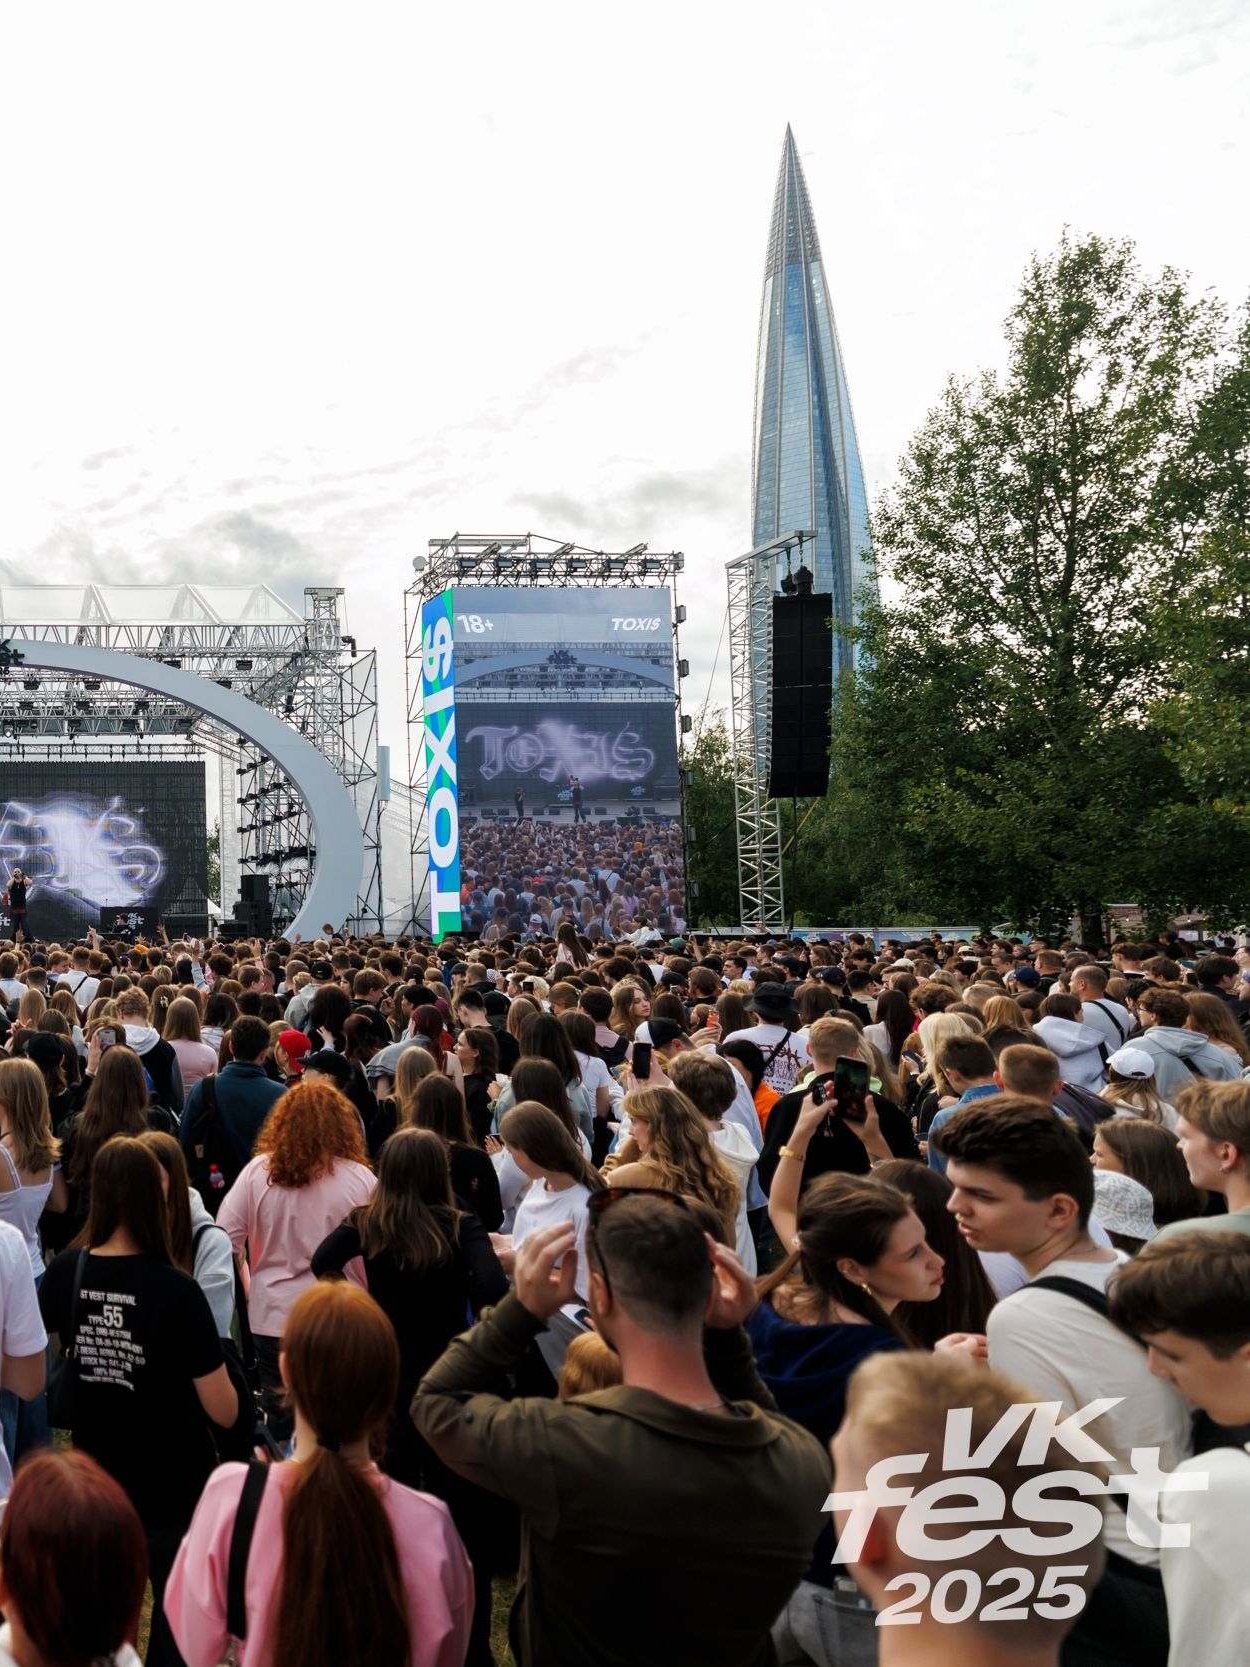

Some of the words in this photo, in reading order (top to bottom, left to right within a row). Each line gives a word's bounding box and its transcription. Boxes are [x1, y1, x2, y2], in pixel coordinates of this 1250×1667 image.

[457, 614, 494, 633] 18+
[89, 1290, 106, 1302] VEST
[106, 1293, 137, 1306] SURVIVAL
[88, 1314, 104, 1326] TYPE
[103, 1304, 123, 1329] 55
